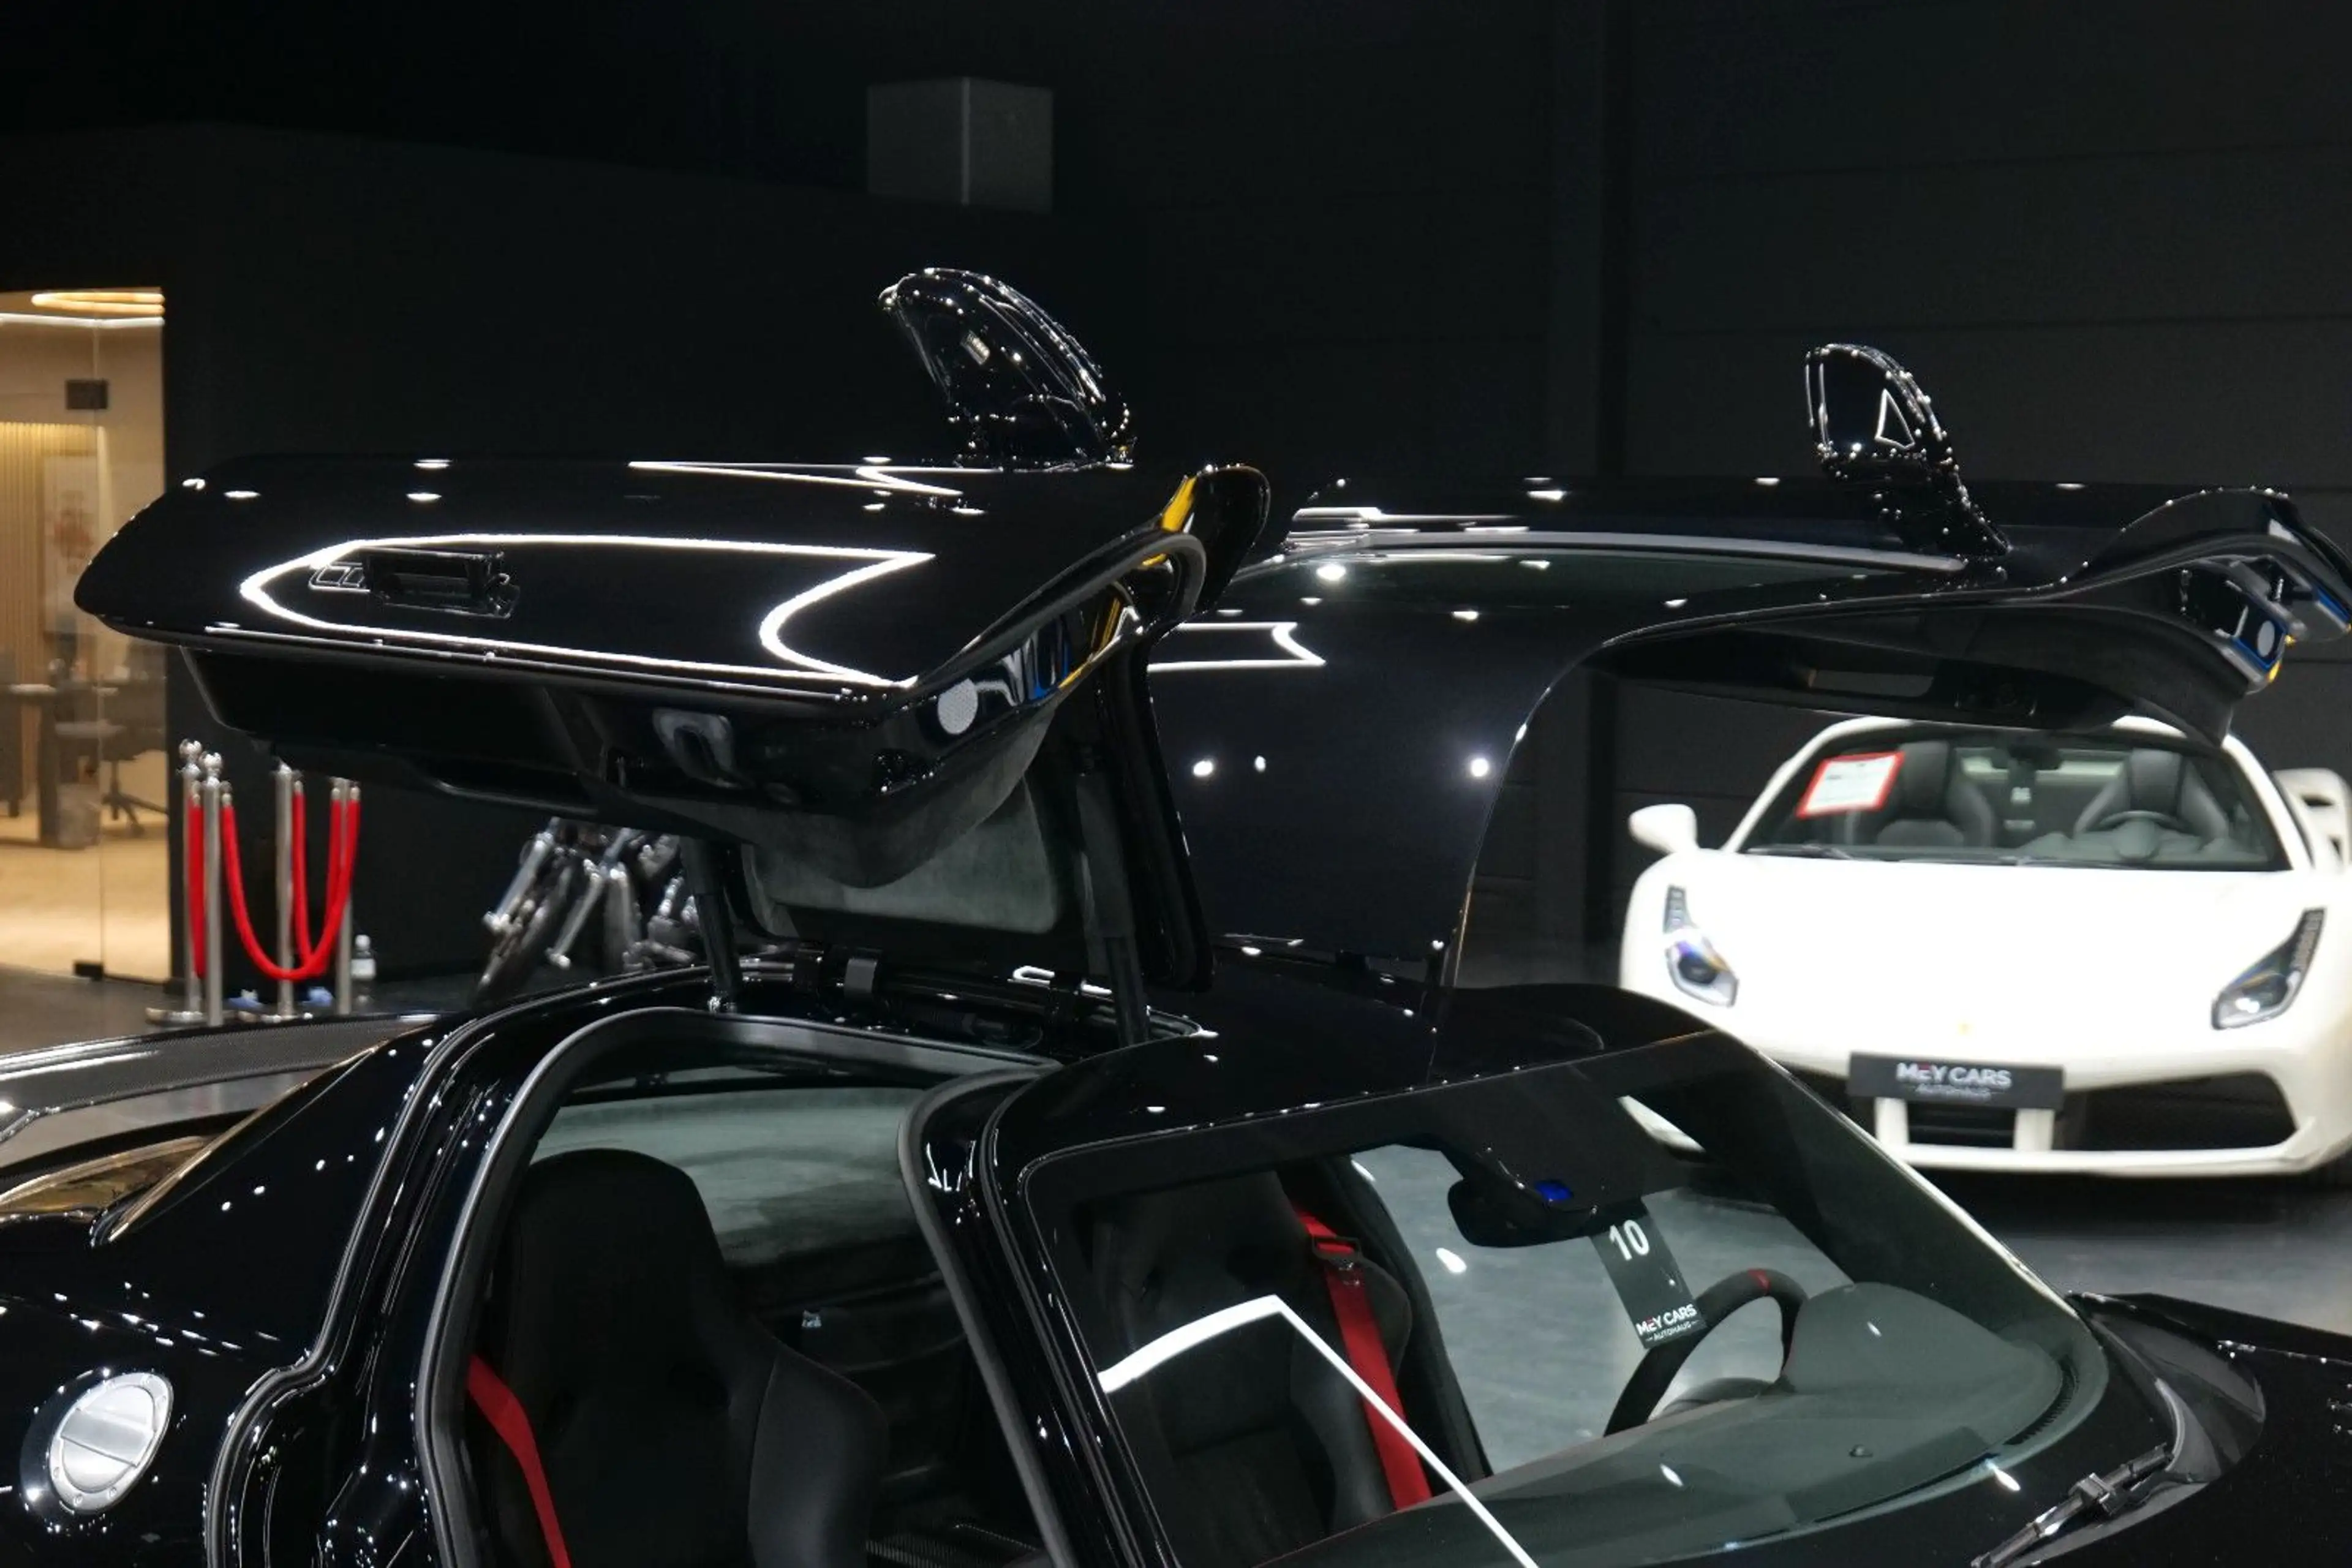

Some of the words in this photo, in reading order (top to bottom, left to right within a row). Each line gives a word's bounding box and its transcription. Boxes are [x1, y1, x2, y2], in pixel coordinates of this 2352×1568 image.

[1948, 1066, 2012, 1089] CARS
[1609, 1219, 1650, 1261] 10
[1635, 1316, 1662, 1336] MEY
[1663, 1303, 1697, 1324] CARS
